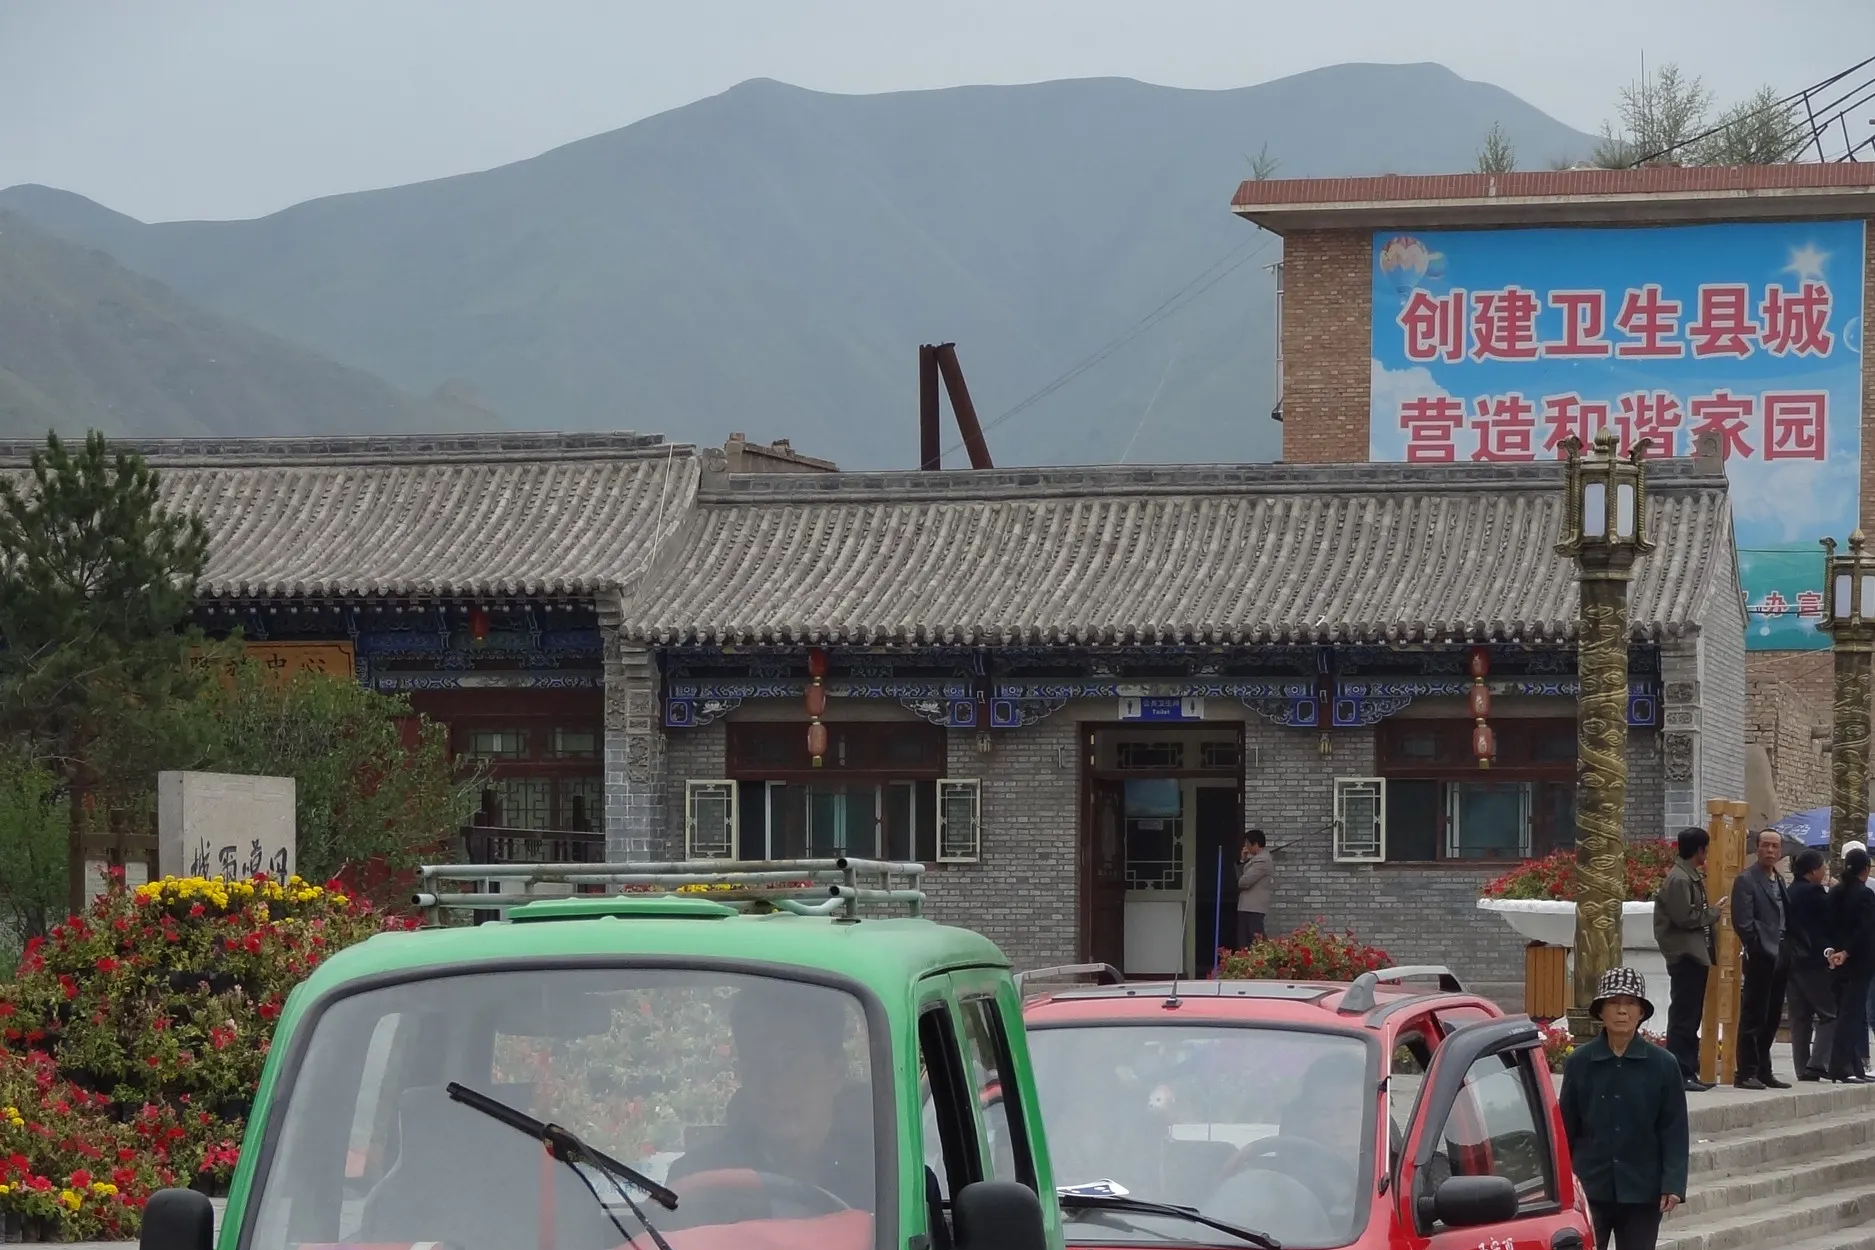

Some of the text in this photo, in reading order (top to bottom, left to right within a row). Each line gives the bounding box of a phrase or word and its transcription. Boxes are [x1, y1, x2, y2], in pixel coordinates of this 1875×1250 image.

[1398, 283, 1833, 361] 创建卫生县城
[1399, 392, 1828, 462] 营造和谐家园
